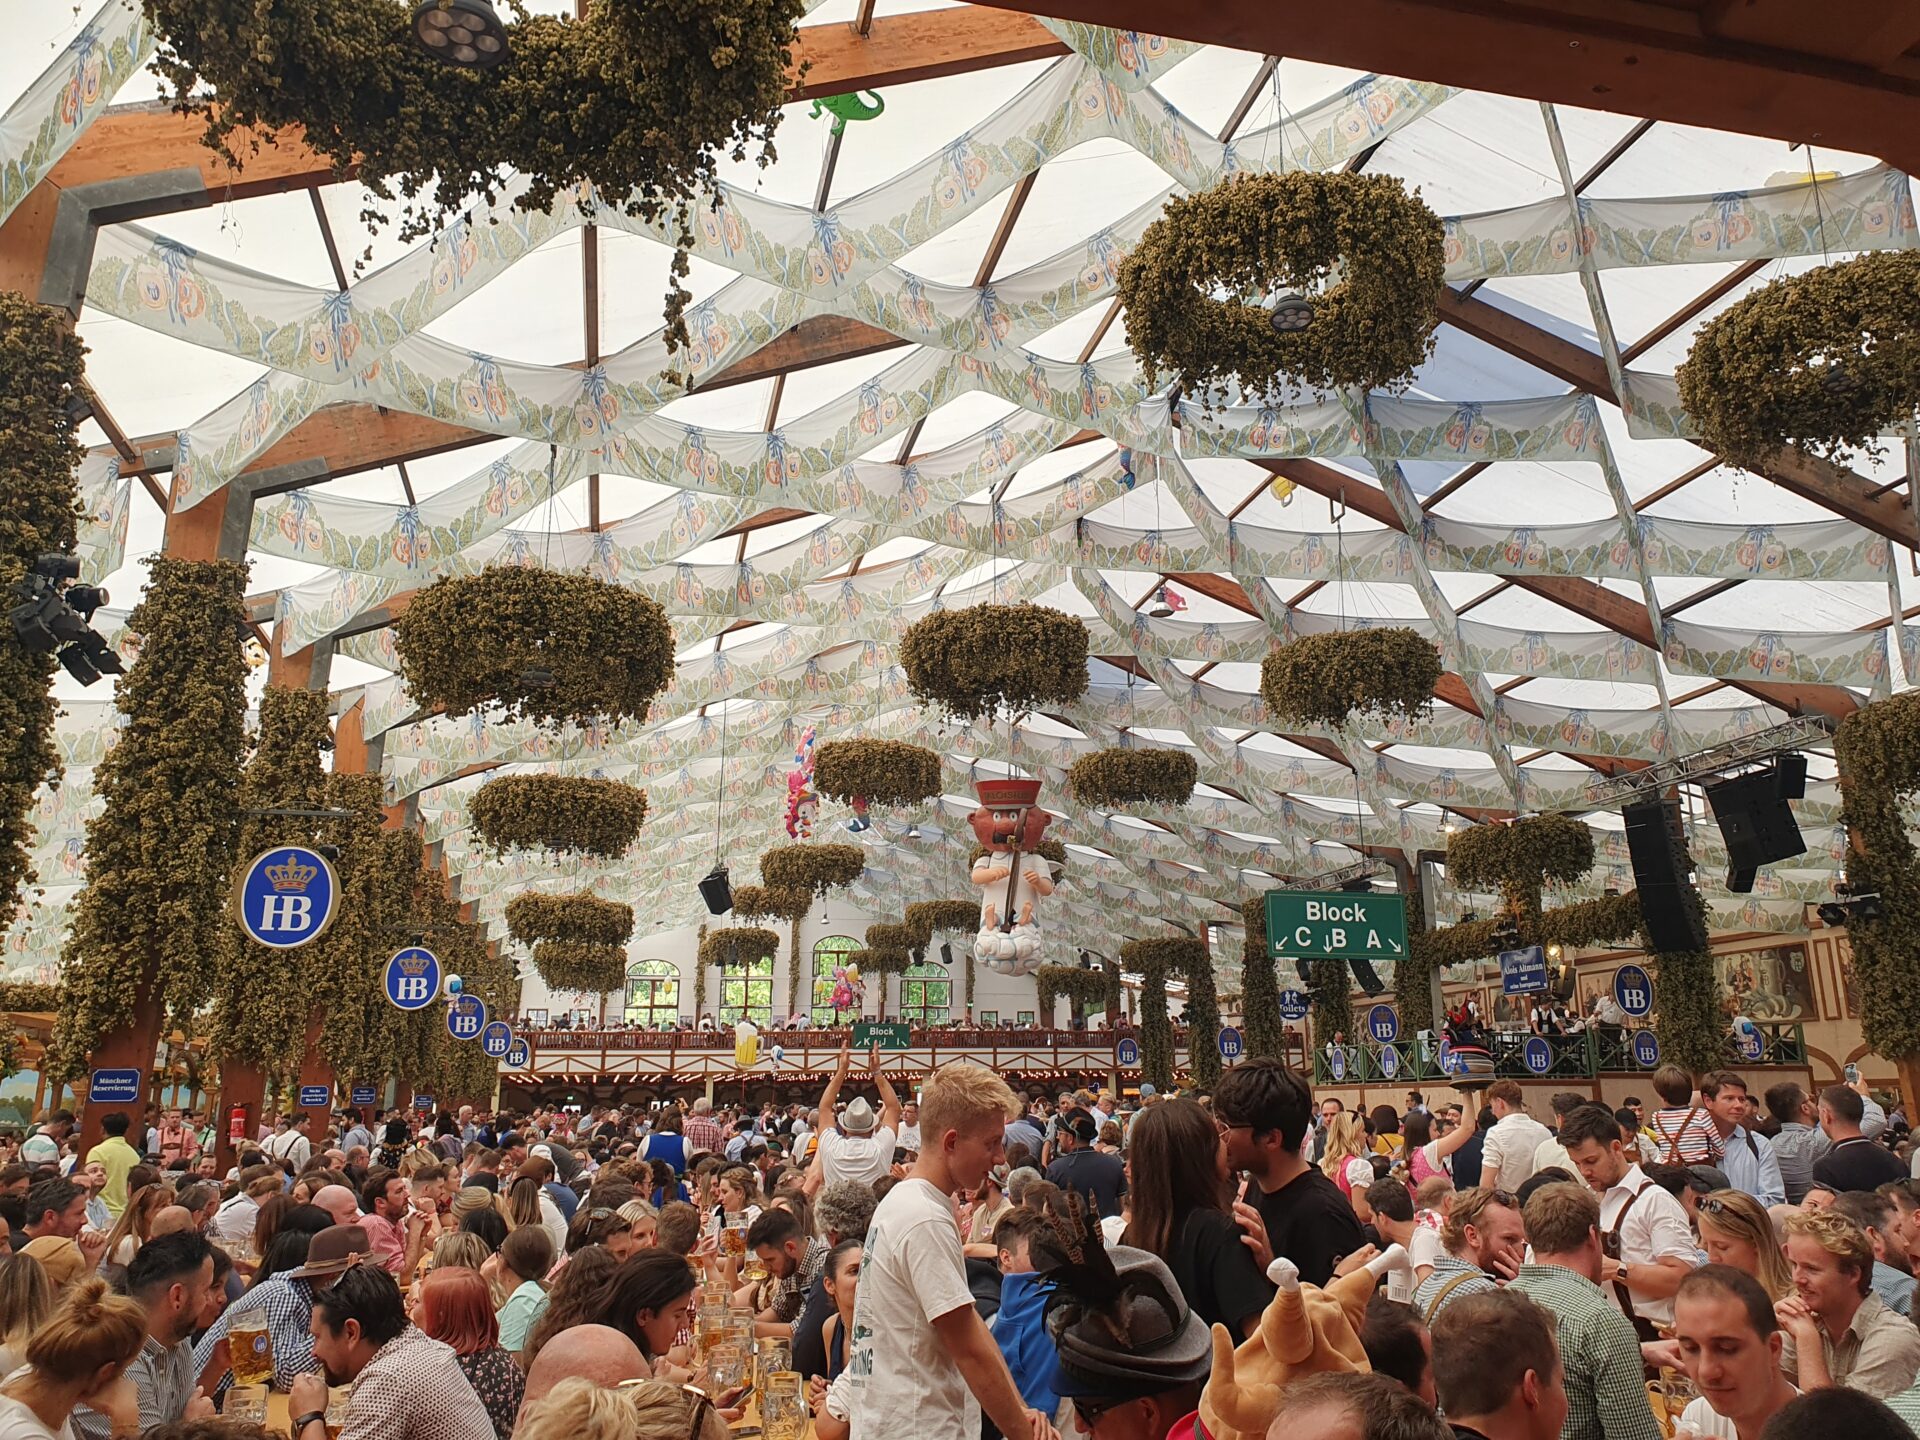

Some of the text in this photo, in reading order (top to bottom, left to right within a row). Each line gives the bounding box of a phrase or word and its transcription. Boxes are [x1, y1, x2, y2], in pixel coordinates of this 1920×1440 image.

[259, 894, 312, 931] HB
[1305, 901, 1367, 922] Block
[1295, 926, 1382, 949] C B A
[396, 977, 428, 1000] HB
[1623, 989, 1646, 1009] HB
[454, 1016, 478, 1033] HB
[869, 1027, 894, 1036] Block
[1375, 1023, 1393, 1038] HB
[488, 1038, 506, 1052] HB
[864, 1037, 870, 1046] K
[881, 1037, 887, 1046] J
[1223, 1042, 1238, 1054] HB
[509, 1052, 524, 1064] HB
[1122, 1051, 1134, 1062] HB
[1530, 1054, 1547, 1068] HB
[1639, 1047, 1655, 1061] HB
